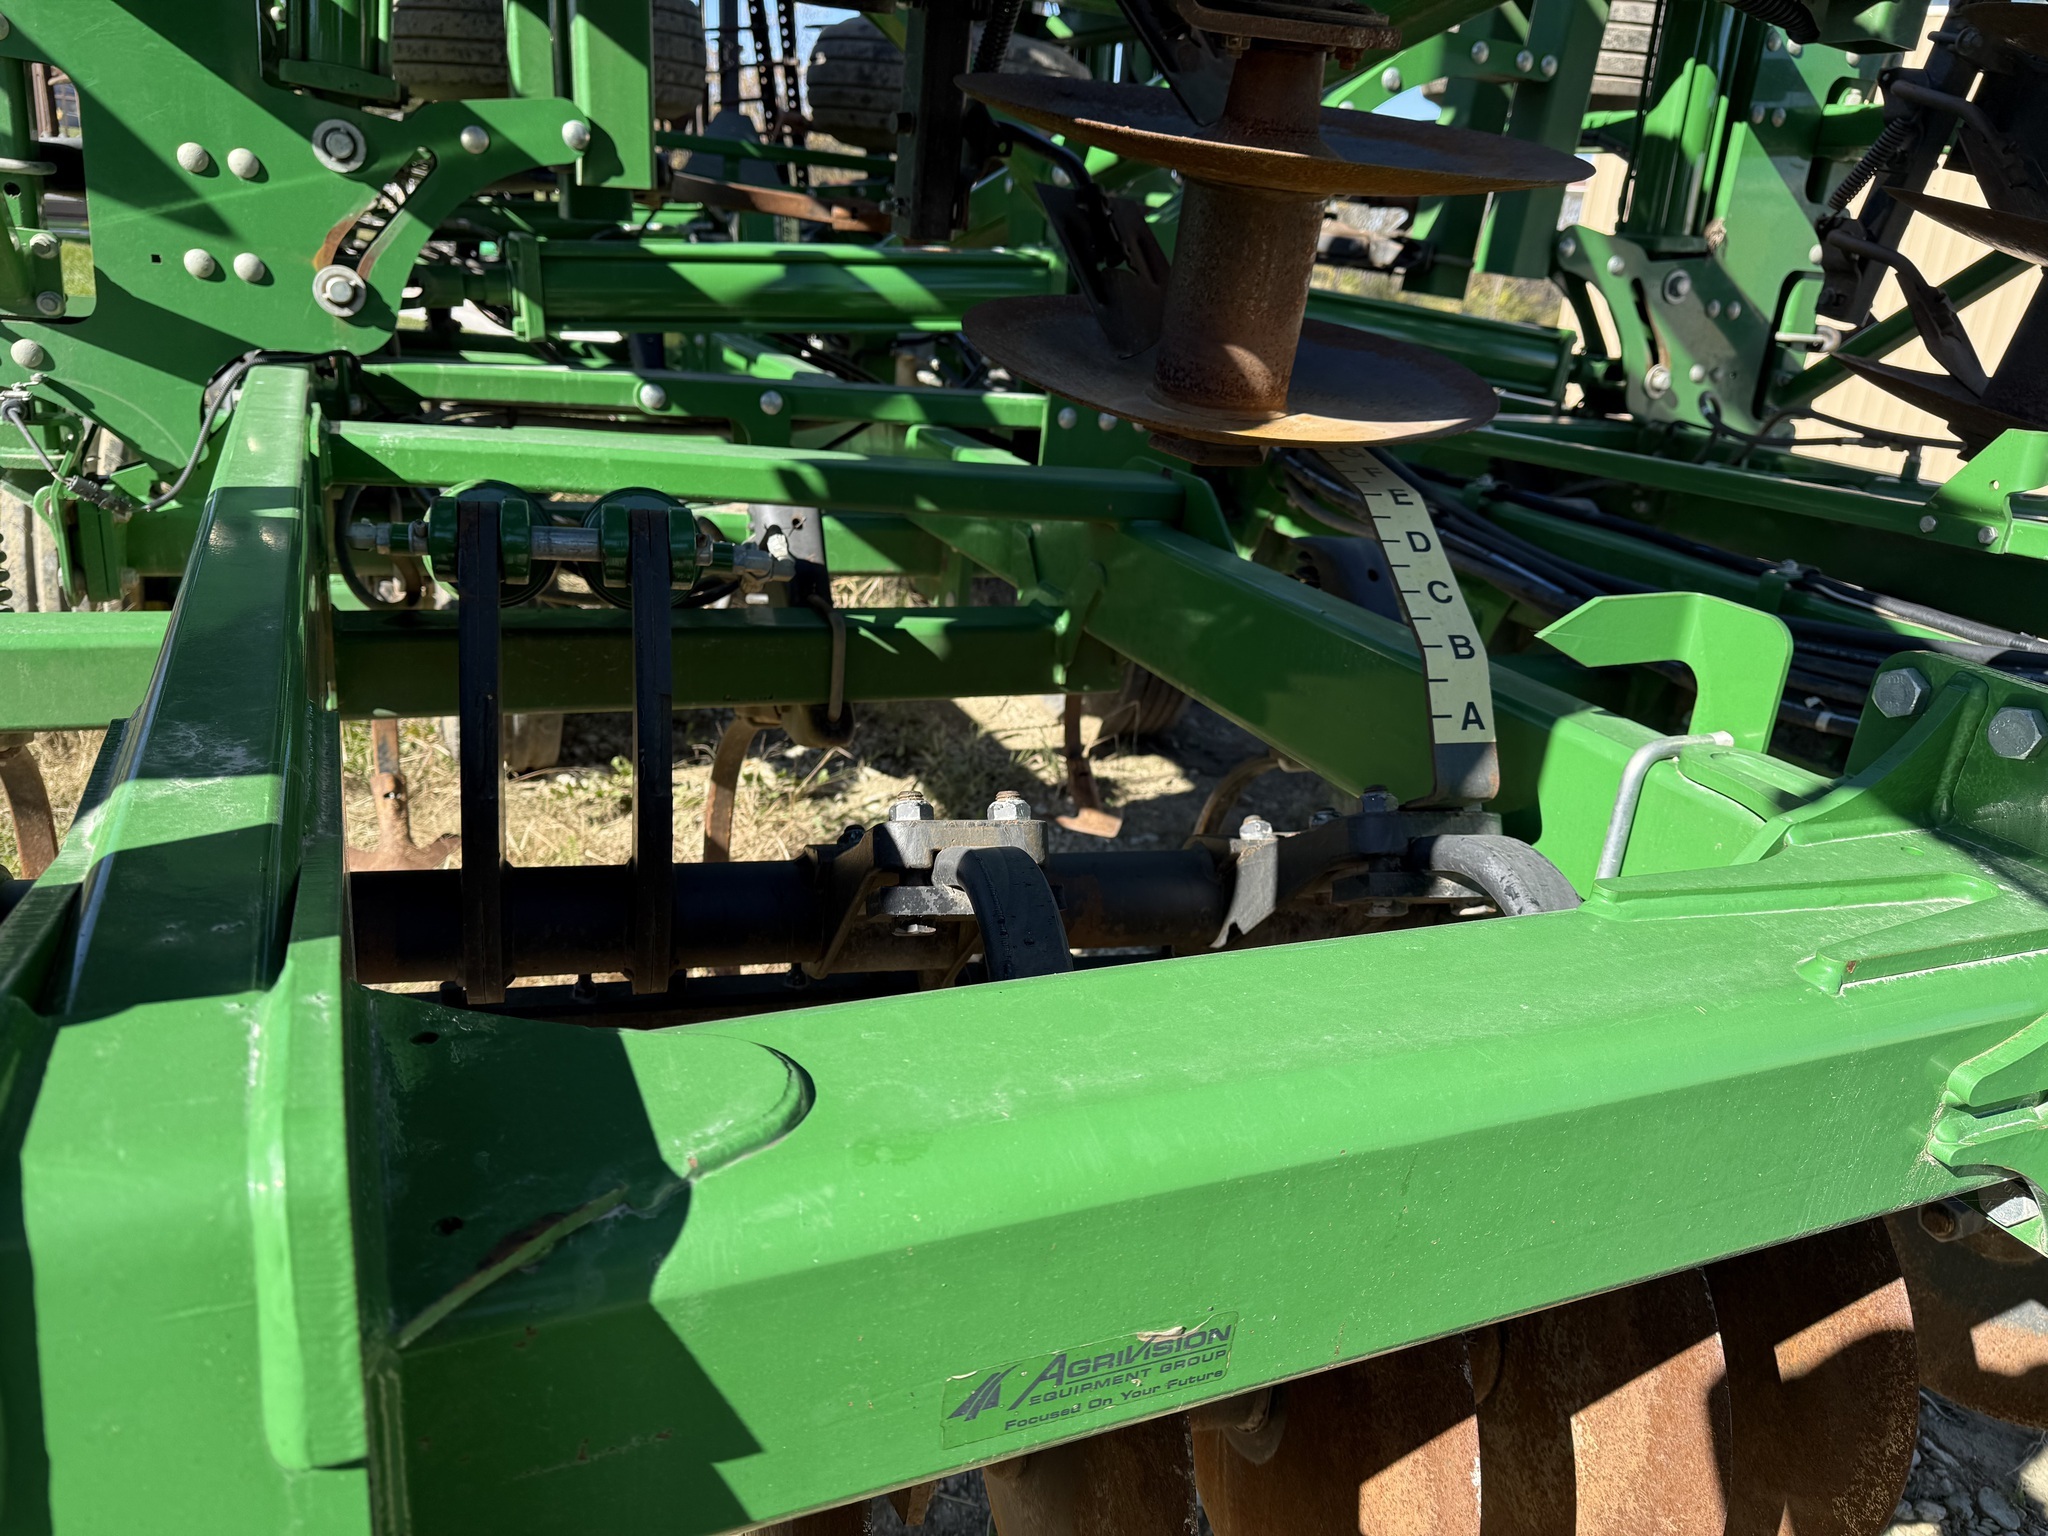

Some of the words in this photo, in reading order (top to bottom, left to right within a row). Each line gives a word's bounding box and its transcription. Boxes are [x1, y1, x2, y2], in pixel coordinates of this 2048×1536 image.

[1362, 467, 1383, 478] F
[1387, 488, 1414, 505] E
[1406, 531, 1432, 552] D
[1427, 580, 1453, 604] C
[1448, 634, 1475, 660] B
[1461, 701, 1486, 731] A
[1028, 1368, 1150, 1406] EQUIPMENT
[1159, 1349, 1227, 1374] GROUP
[1004, 1404, 1081, 1431] Focused
[1087, 1397, 1113, 1411] On
[1120, 1384, 1162, 1402] Your
[1166, 1368, 1224, 1389] Future
